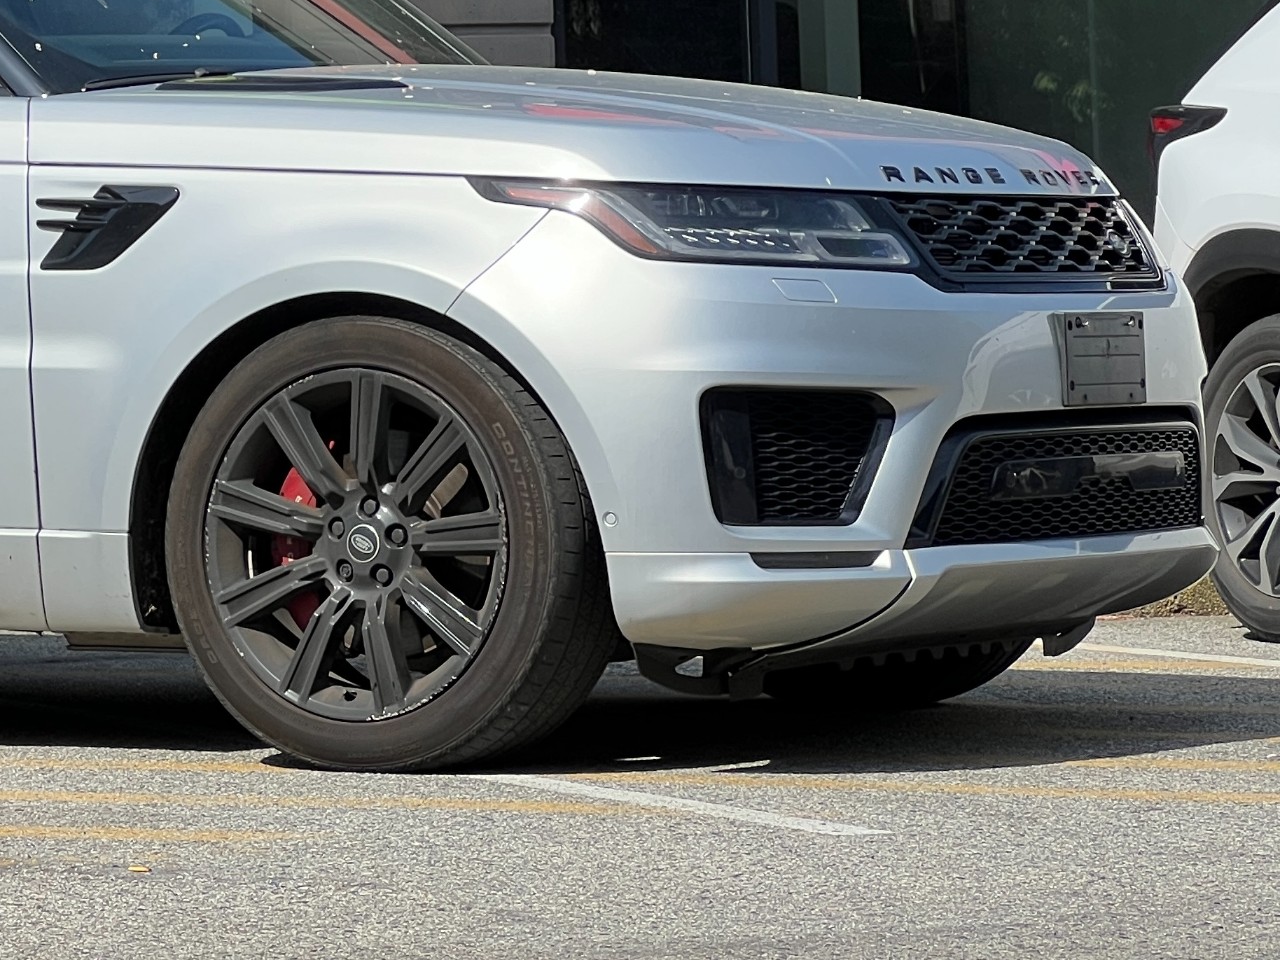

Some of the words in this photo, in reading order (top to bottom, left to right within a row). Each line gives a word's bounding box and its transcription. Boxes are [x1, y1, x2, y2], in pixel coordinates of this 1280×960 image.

[878, 164, 1007, 185] RANGE
[1019, 168, 1102, 187] ROVER
[492, 420, 538, 596] CONTINENT
